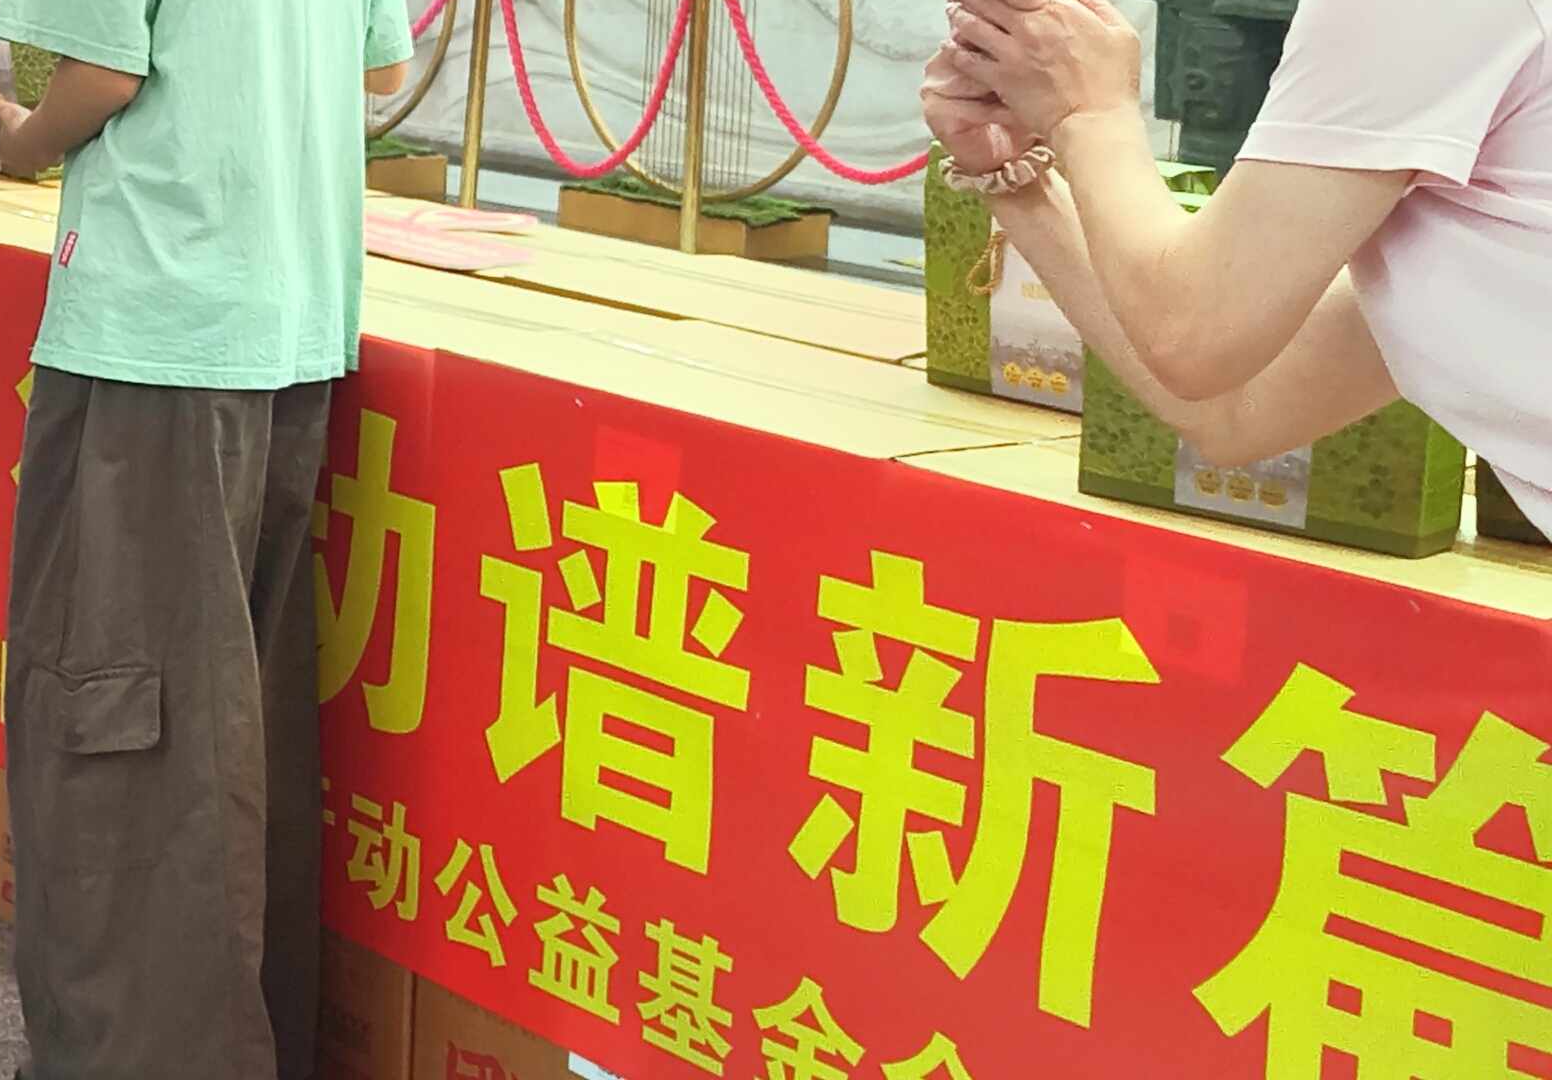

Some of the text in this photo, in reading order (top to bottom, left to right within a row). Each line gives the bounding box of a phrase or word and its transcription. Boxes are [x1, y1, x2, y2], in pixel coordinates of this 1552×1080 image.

[322, 777, 974, 1080] 动公益基金
